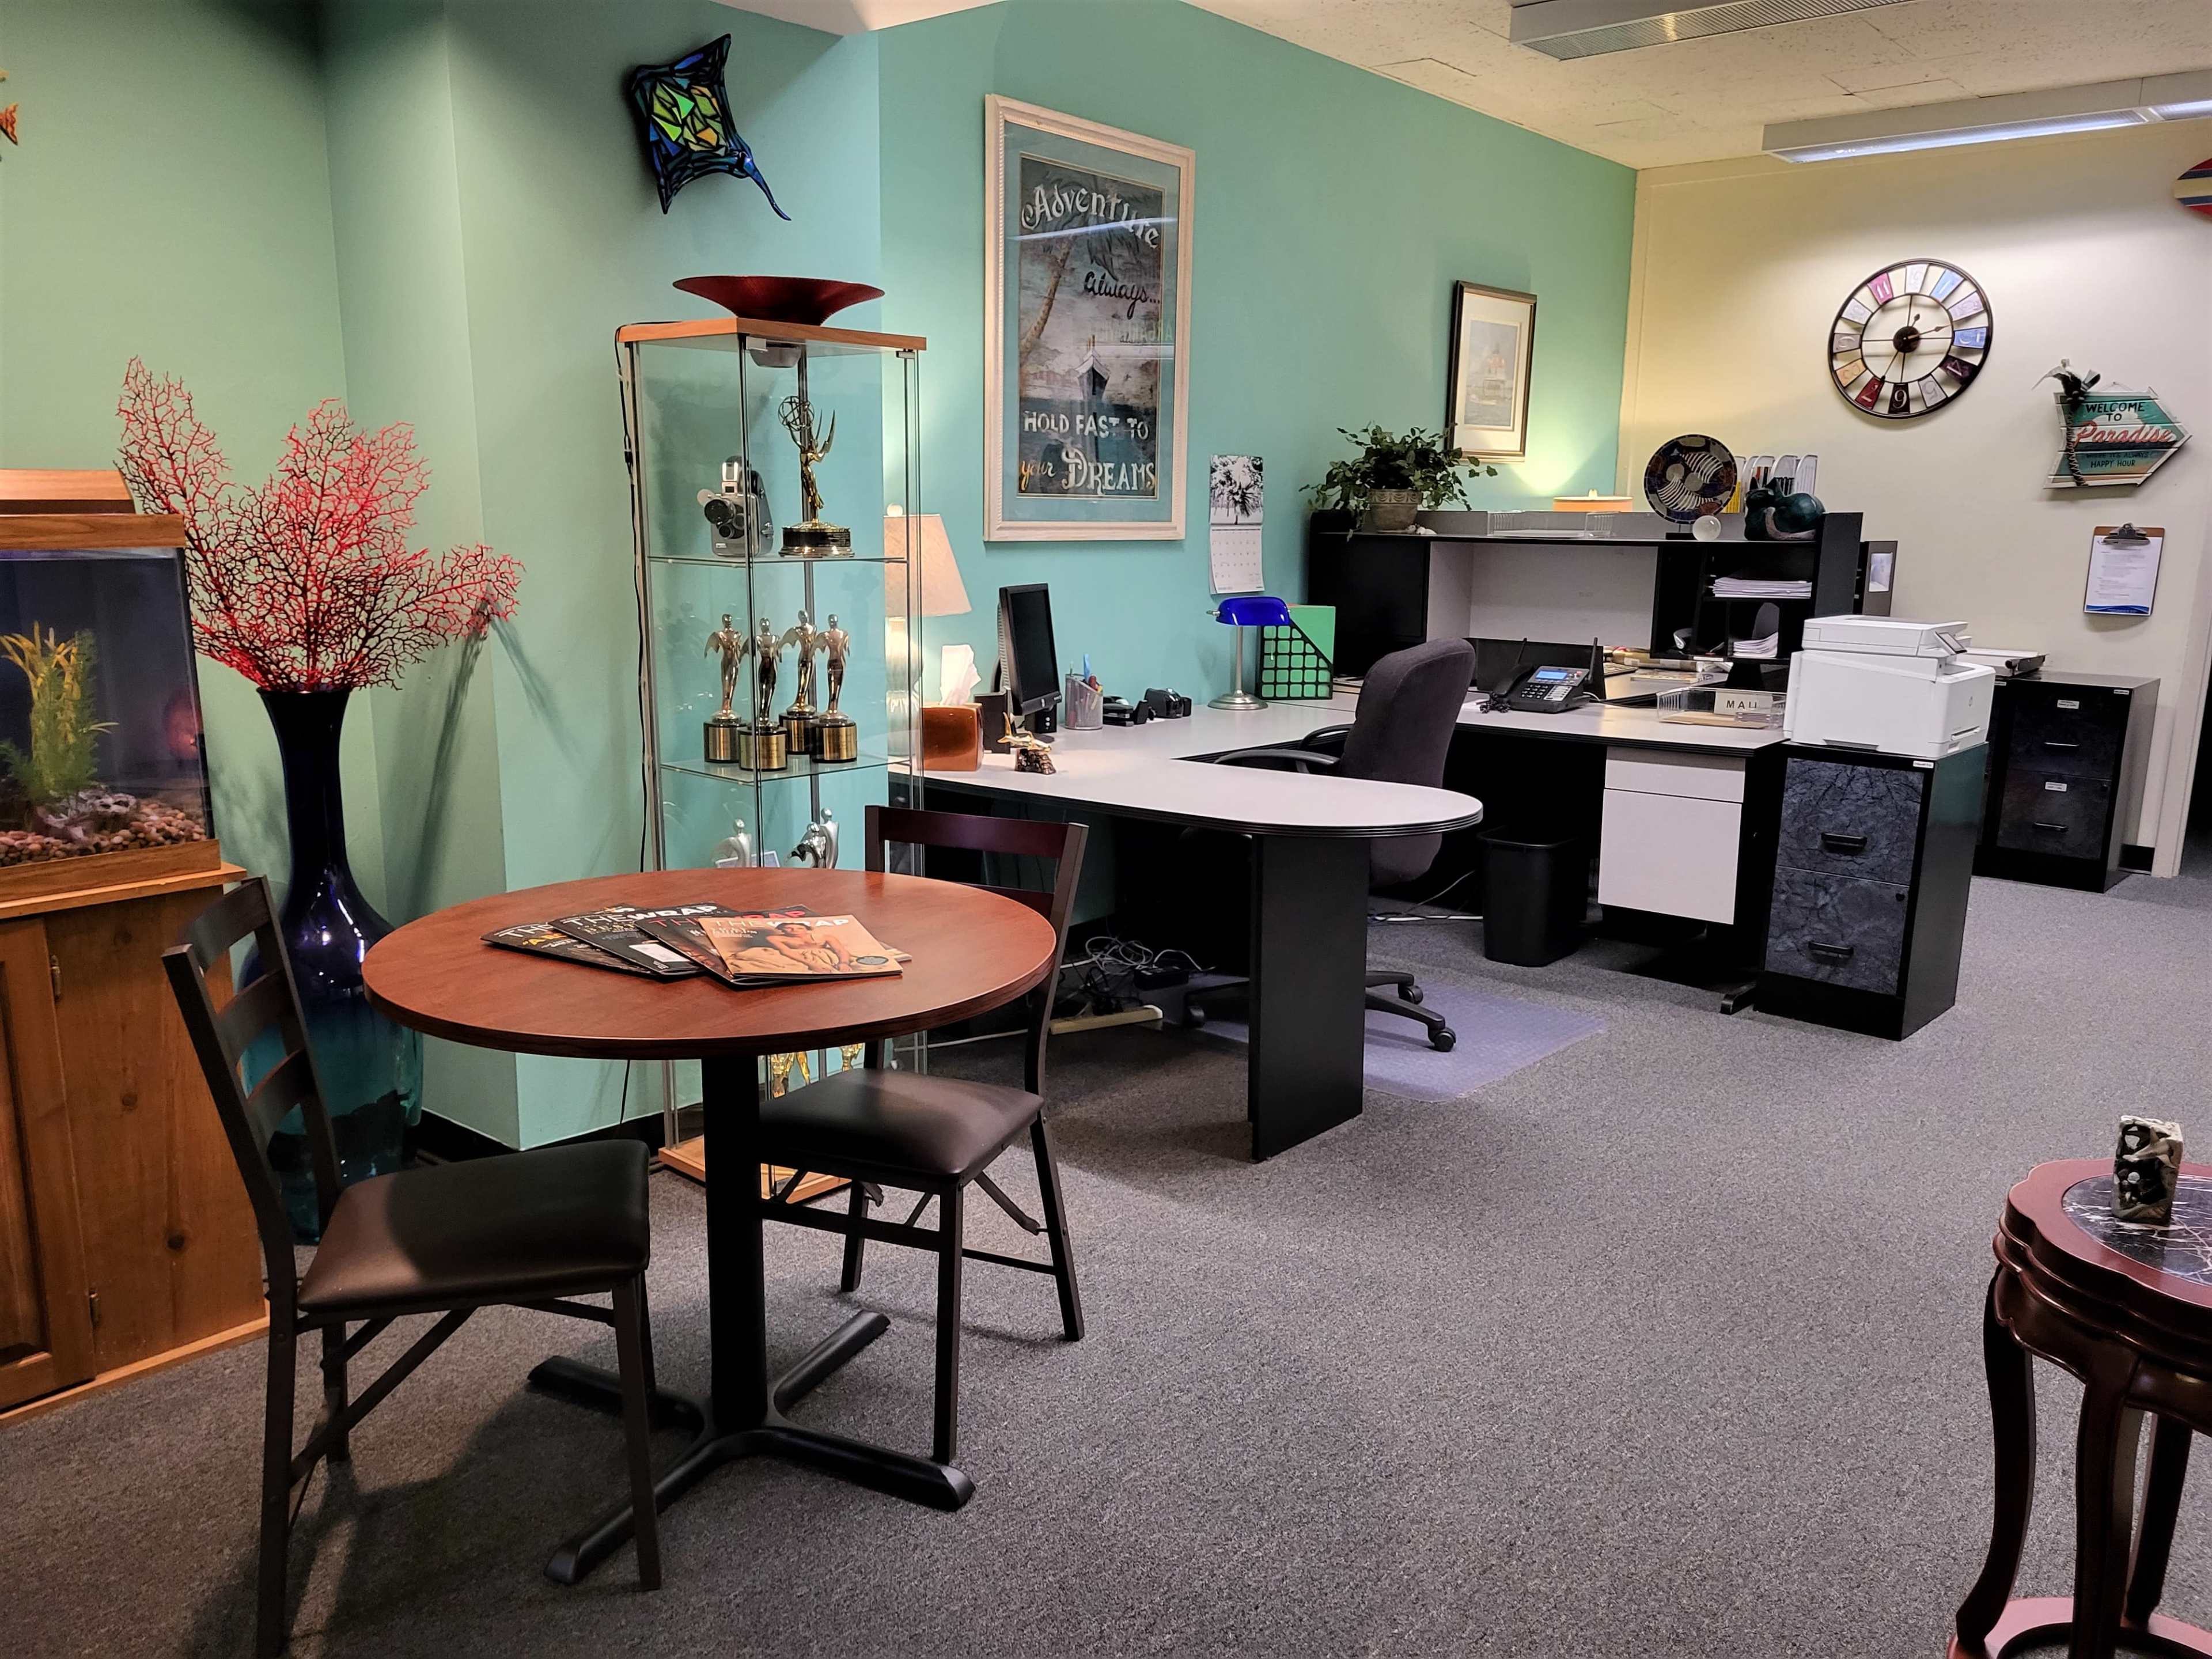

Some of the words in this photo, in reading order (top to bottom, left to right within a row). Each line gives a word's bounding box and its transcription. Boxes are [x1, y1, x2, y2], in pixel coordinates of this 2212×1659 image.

[1021, 184, 1159, 249] Adventure
[2085, 402, 2146, 413] WELCOME
[1024, 411, 1069, 433] HOLD
[1075, 414, 1120, 438] FAST
[1127, 418, 1149, 440] TO
[2074, 421, 2172, 448] Paradise
[1020, 461, 1056, 491] your
